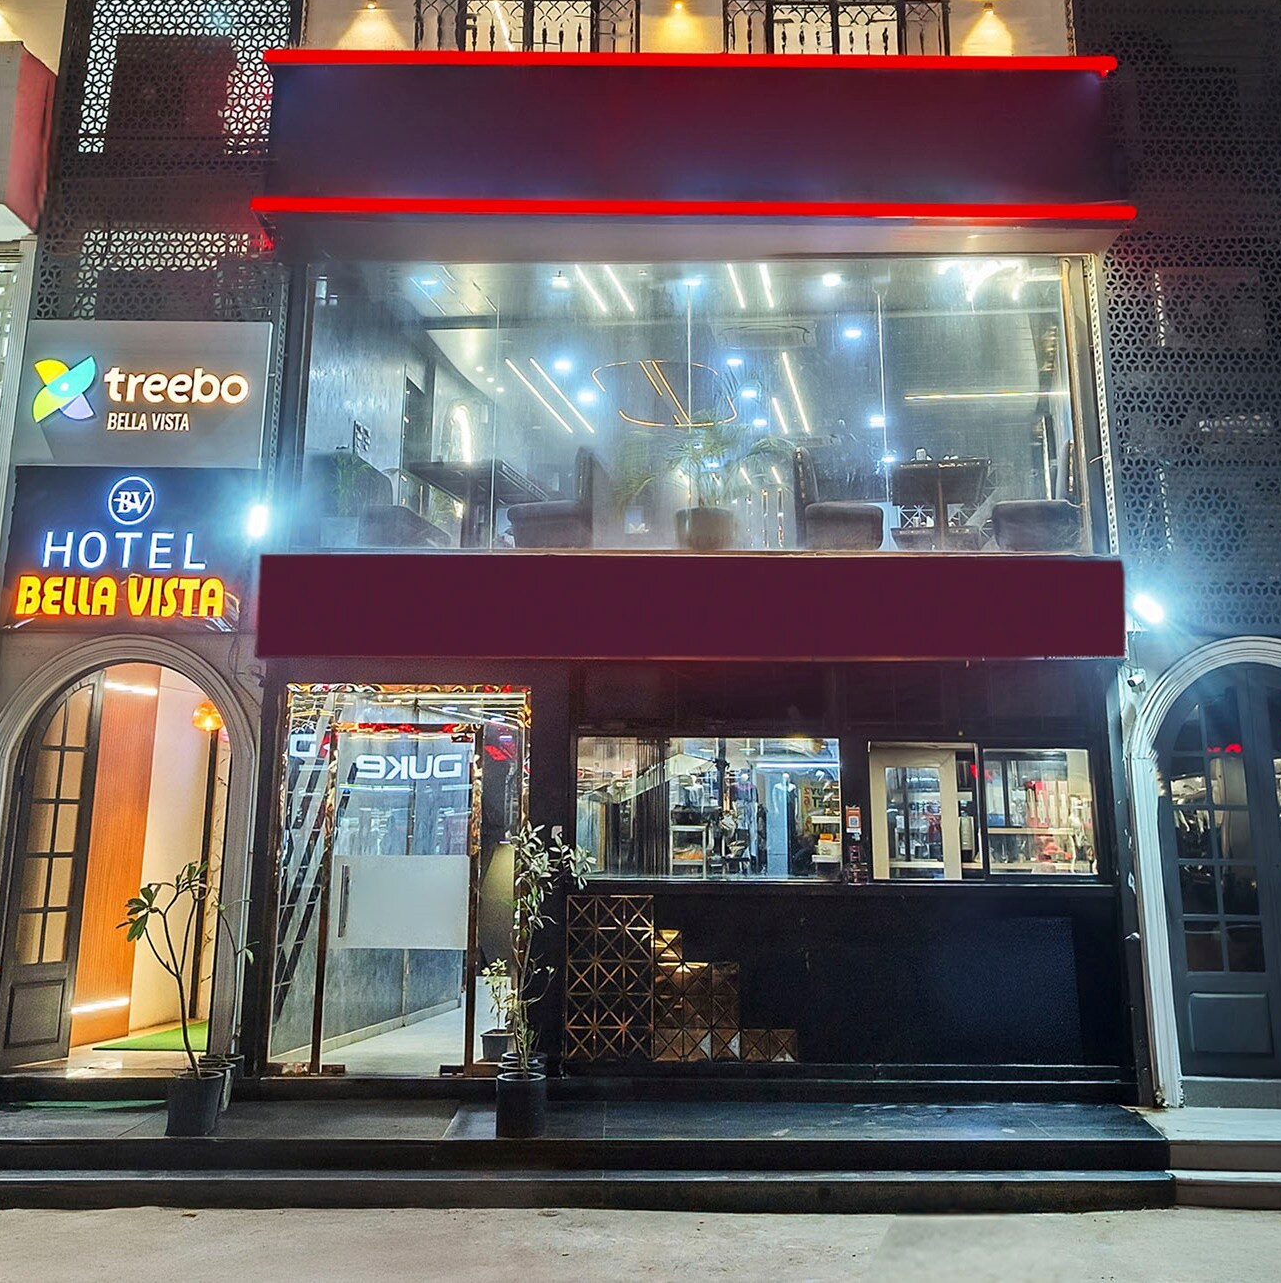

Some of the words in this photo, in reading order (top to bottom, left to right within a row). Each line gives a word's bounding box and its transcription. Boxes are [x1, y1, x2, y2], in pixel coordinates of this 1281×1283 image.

[103, 367, 250, 404] treebo
[107, 413, 148, 431] BELLA
[151, 413, 191, 432] VISTA
[42, 530, 207, 570] HOTEL
[15, 575, 117, 616] BELLA
[127, 576, 226, 618] VISTA
